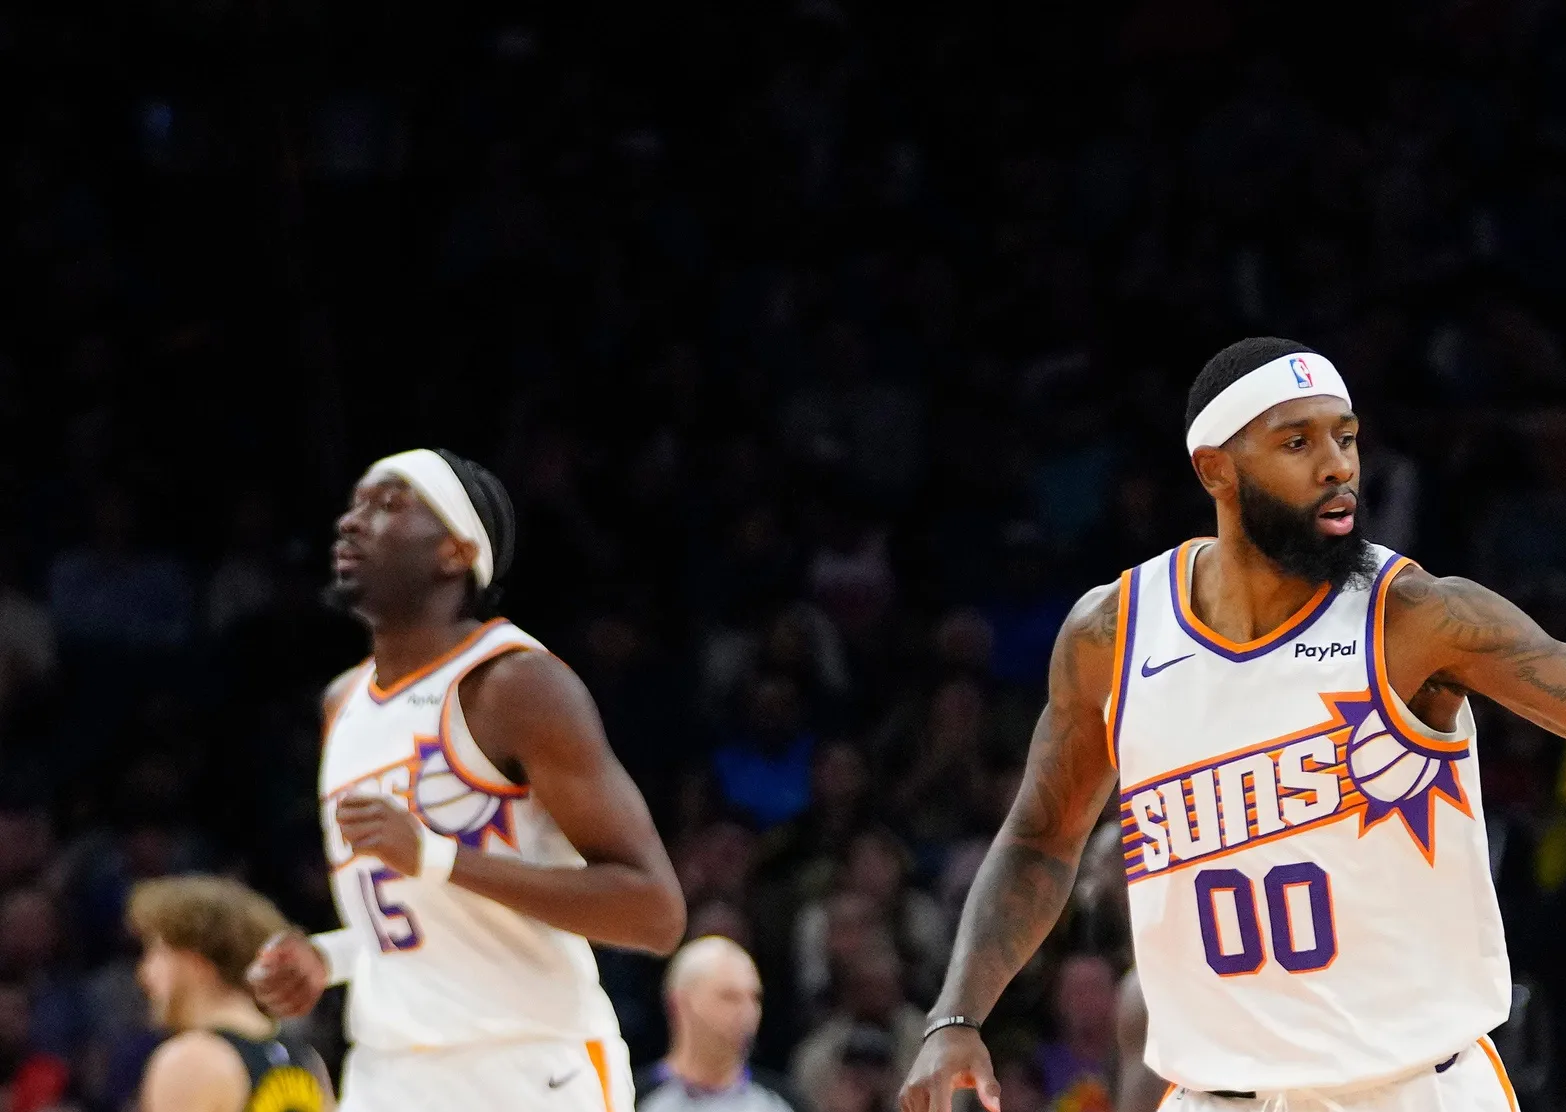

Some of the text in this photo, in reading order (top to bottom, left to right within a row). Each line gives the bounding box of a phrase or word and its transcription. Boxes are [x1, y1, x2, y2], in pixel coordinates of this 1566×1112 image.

[1294, 639, 1358, 662] PayPal
[1131, 734, 1343, 873] SUNS
[357, 865, 425, 953] 15
[1194, 860, 1340, 978] 00
